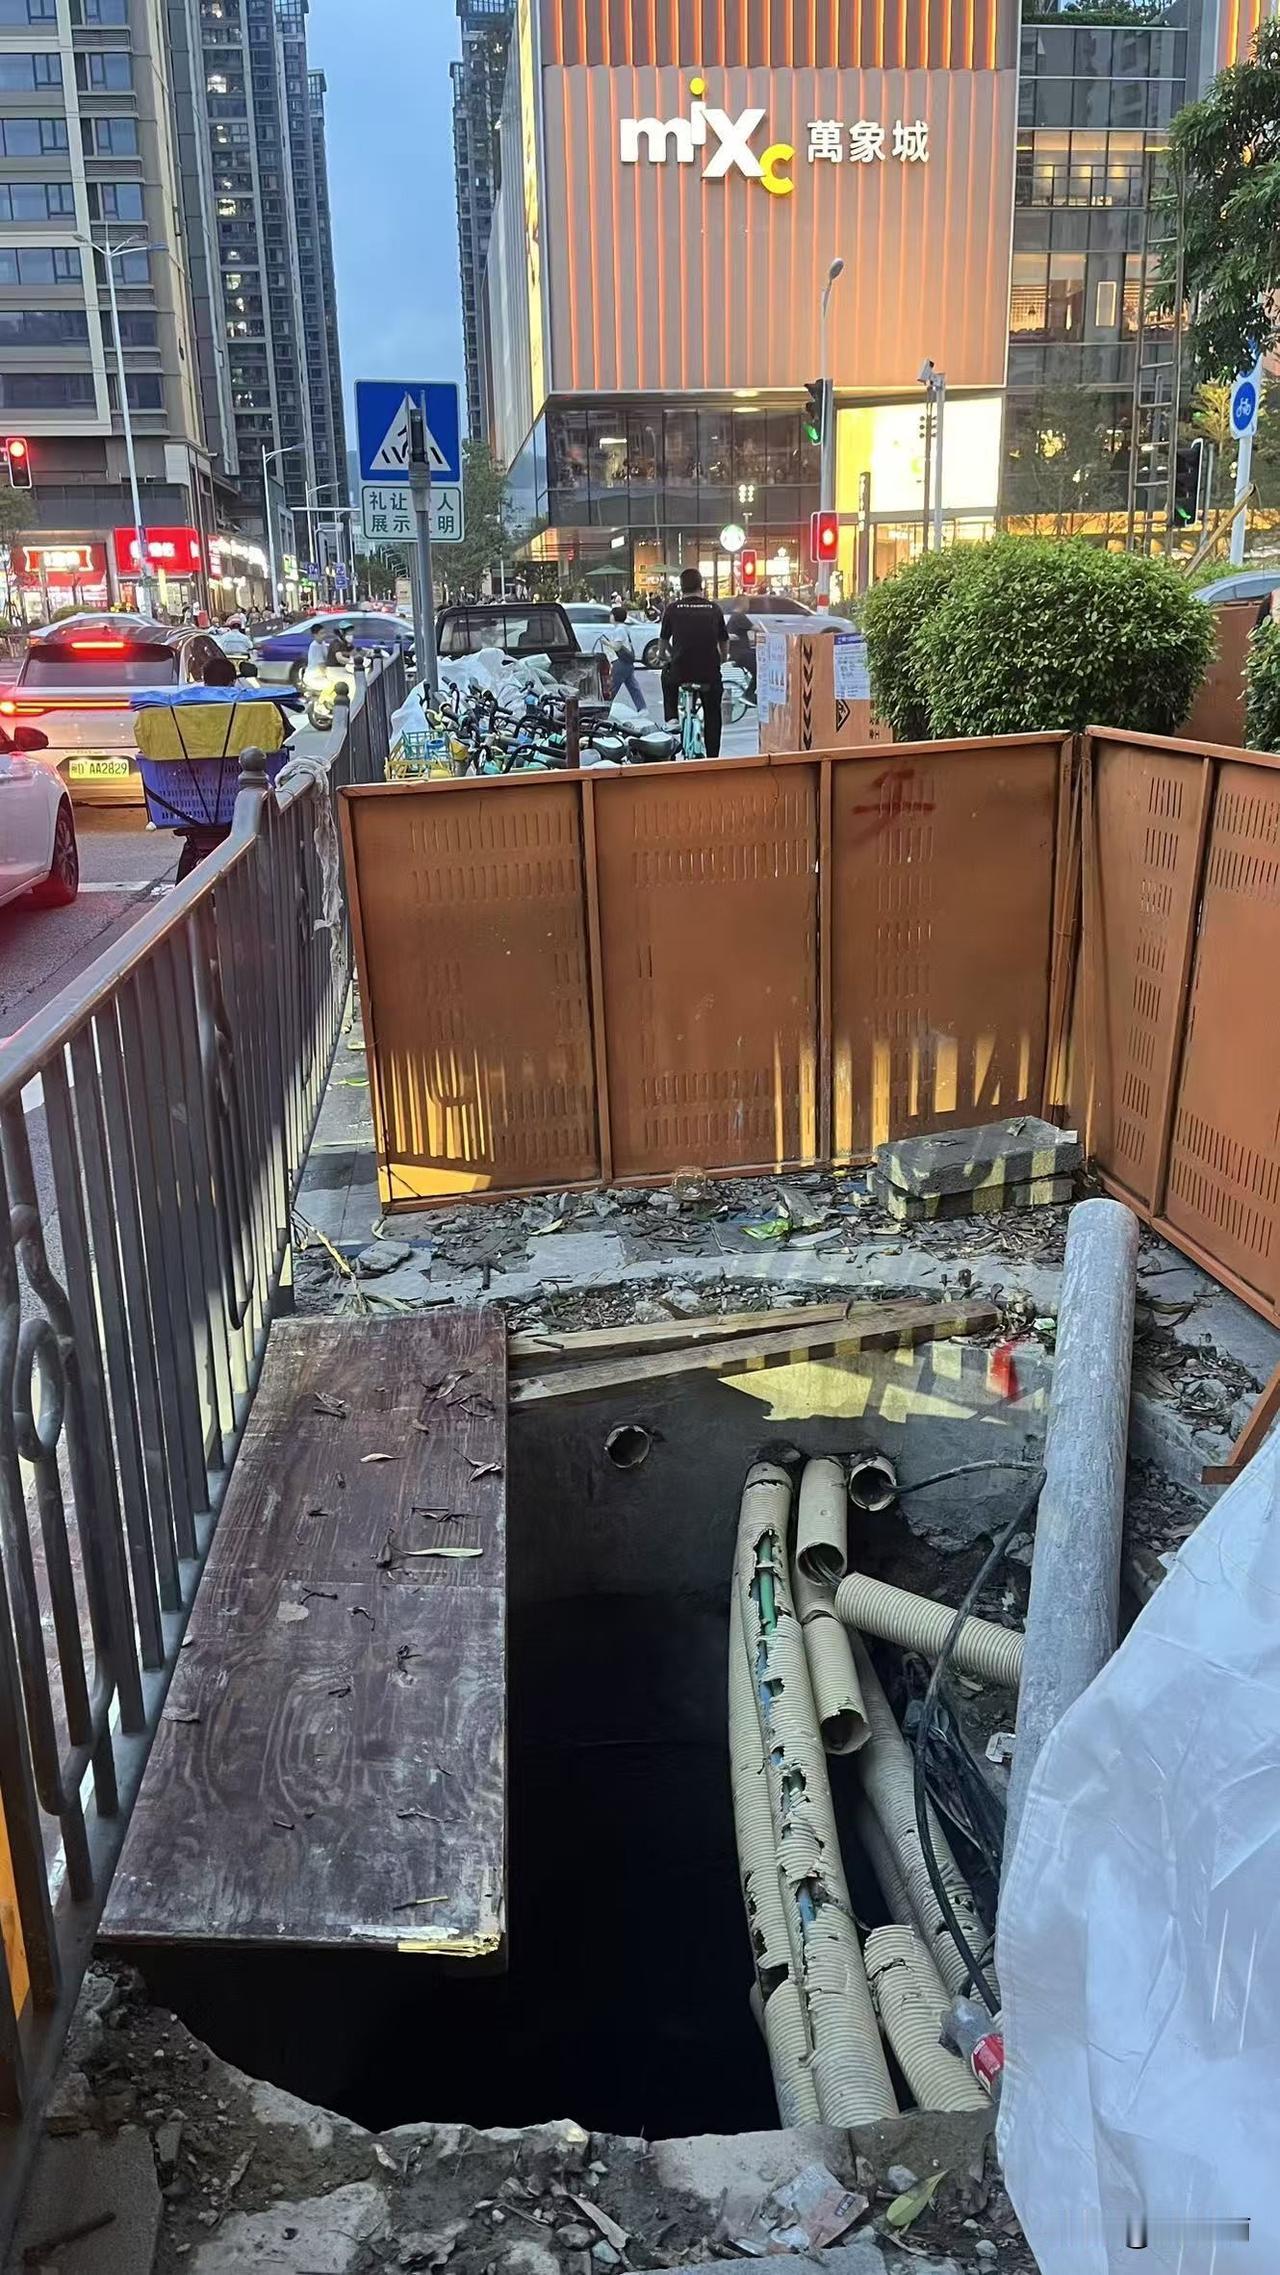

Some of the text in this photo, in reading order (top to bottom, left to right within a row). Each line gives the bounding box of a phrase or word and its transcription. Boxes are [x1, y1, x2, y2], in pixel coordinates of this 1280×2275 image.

[806, 119, 929, 163] 萬象城
[369, 491, 454, 511] 礼让人
[371, 514, 454, 533] 展示明
